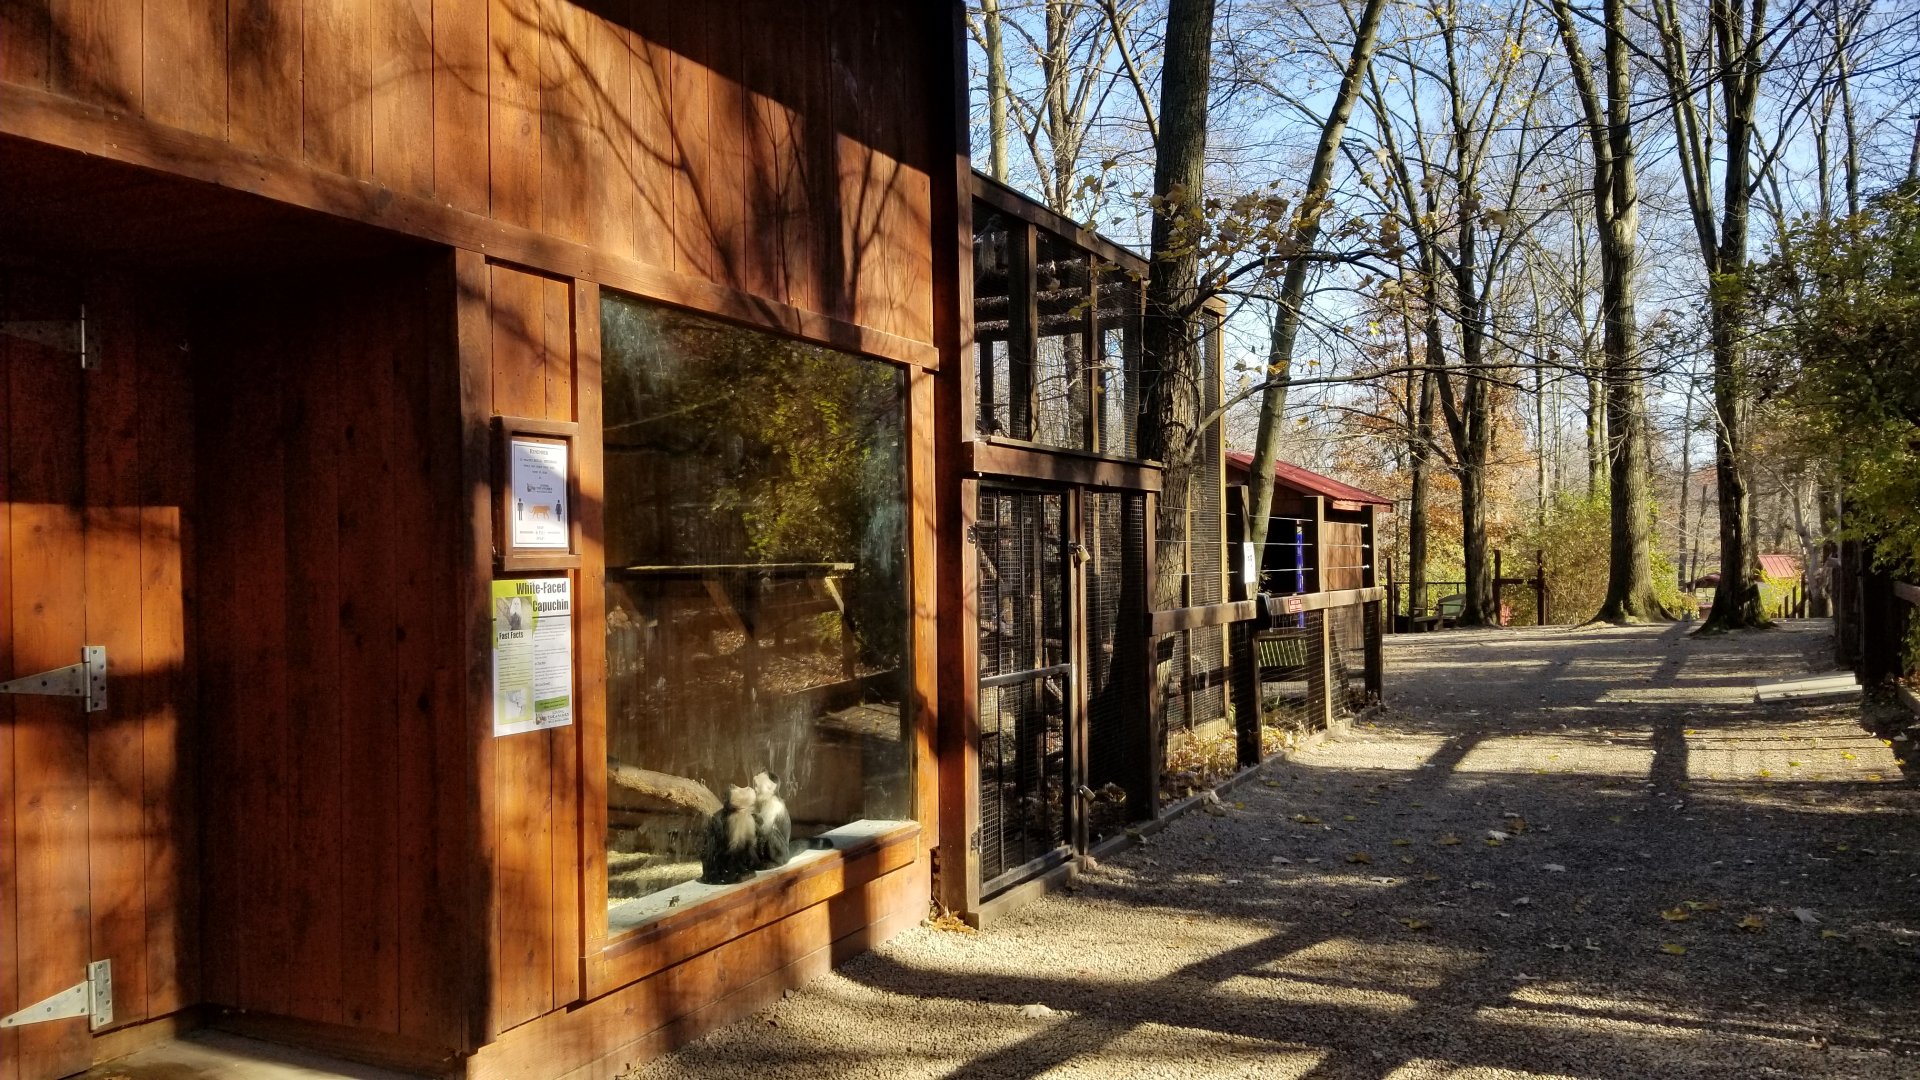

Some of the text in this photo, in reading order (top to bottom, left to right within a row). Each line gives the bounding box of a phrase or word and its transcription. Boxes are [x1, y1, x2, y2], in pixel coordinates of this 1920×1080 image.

[516, 581, 567, 595] White-Faced
[532, 599, 569, 613] Capuchin
[499, 631, 524, 640] Fast Facts
